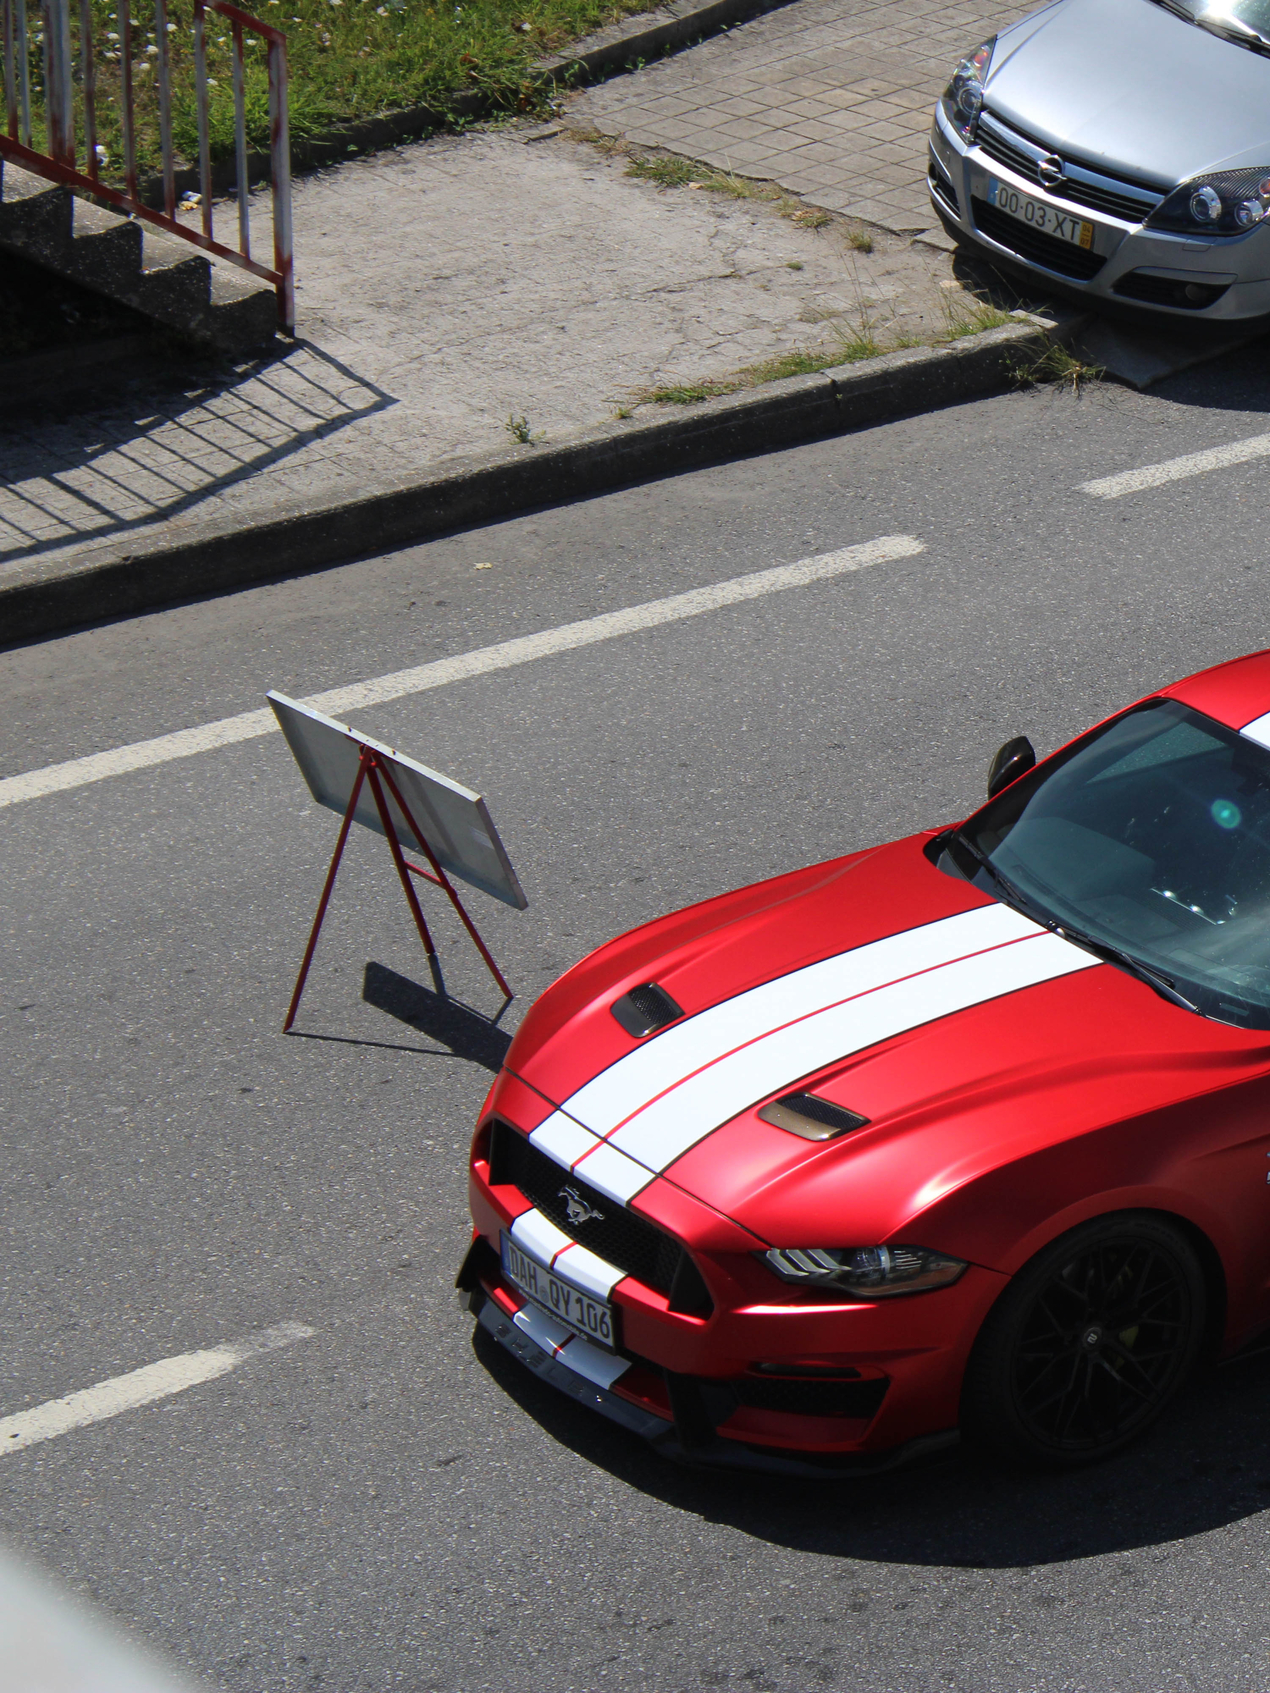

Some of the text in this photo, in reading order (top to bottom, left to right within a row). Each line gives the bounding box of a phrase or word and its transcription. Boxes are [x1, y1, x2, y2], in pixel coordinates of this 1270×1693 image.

[510, 1245, 538, 1296] DAH
[549, 1279, 571, 1317] QY
[575, 1296, 611, 1340] 106
